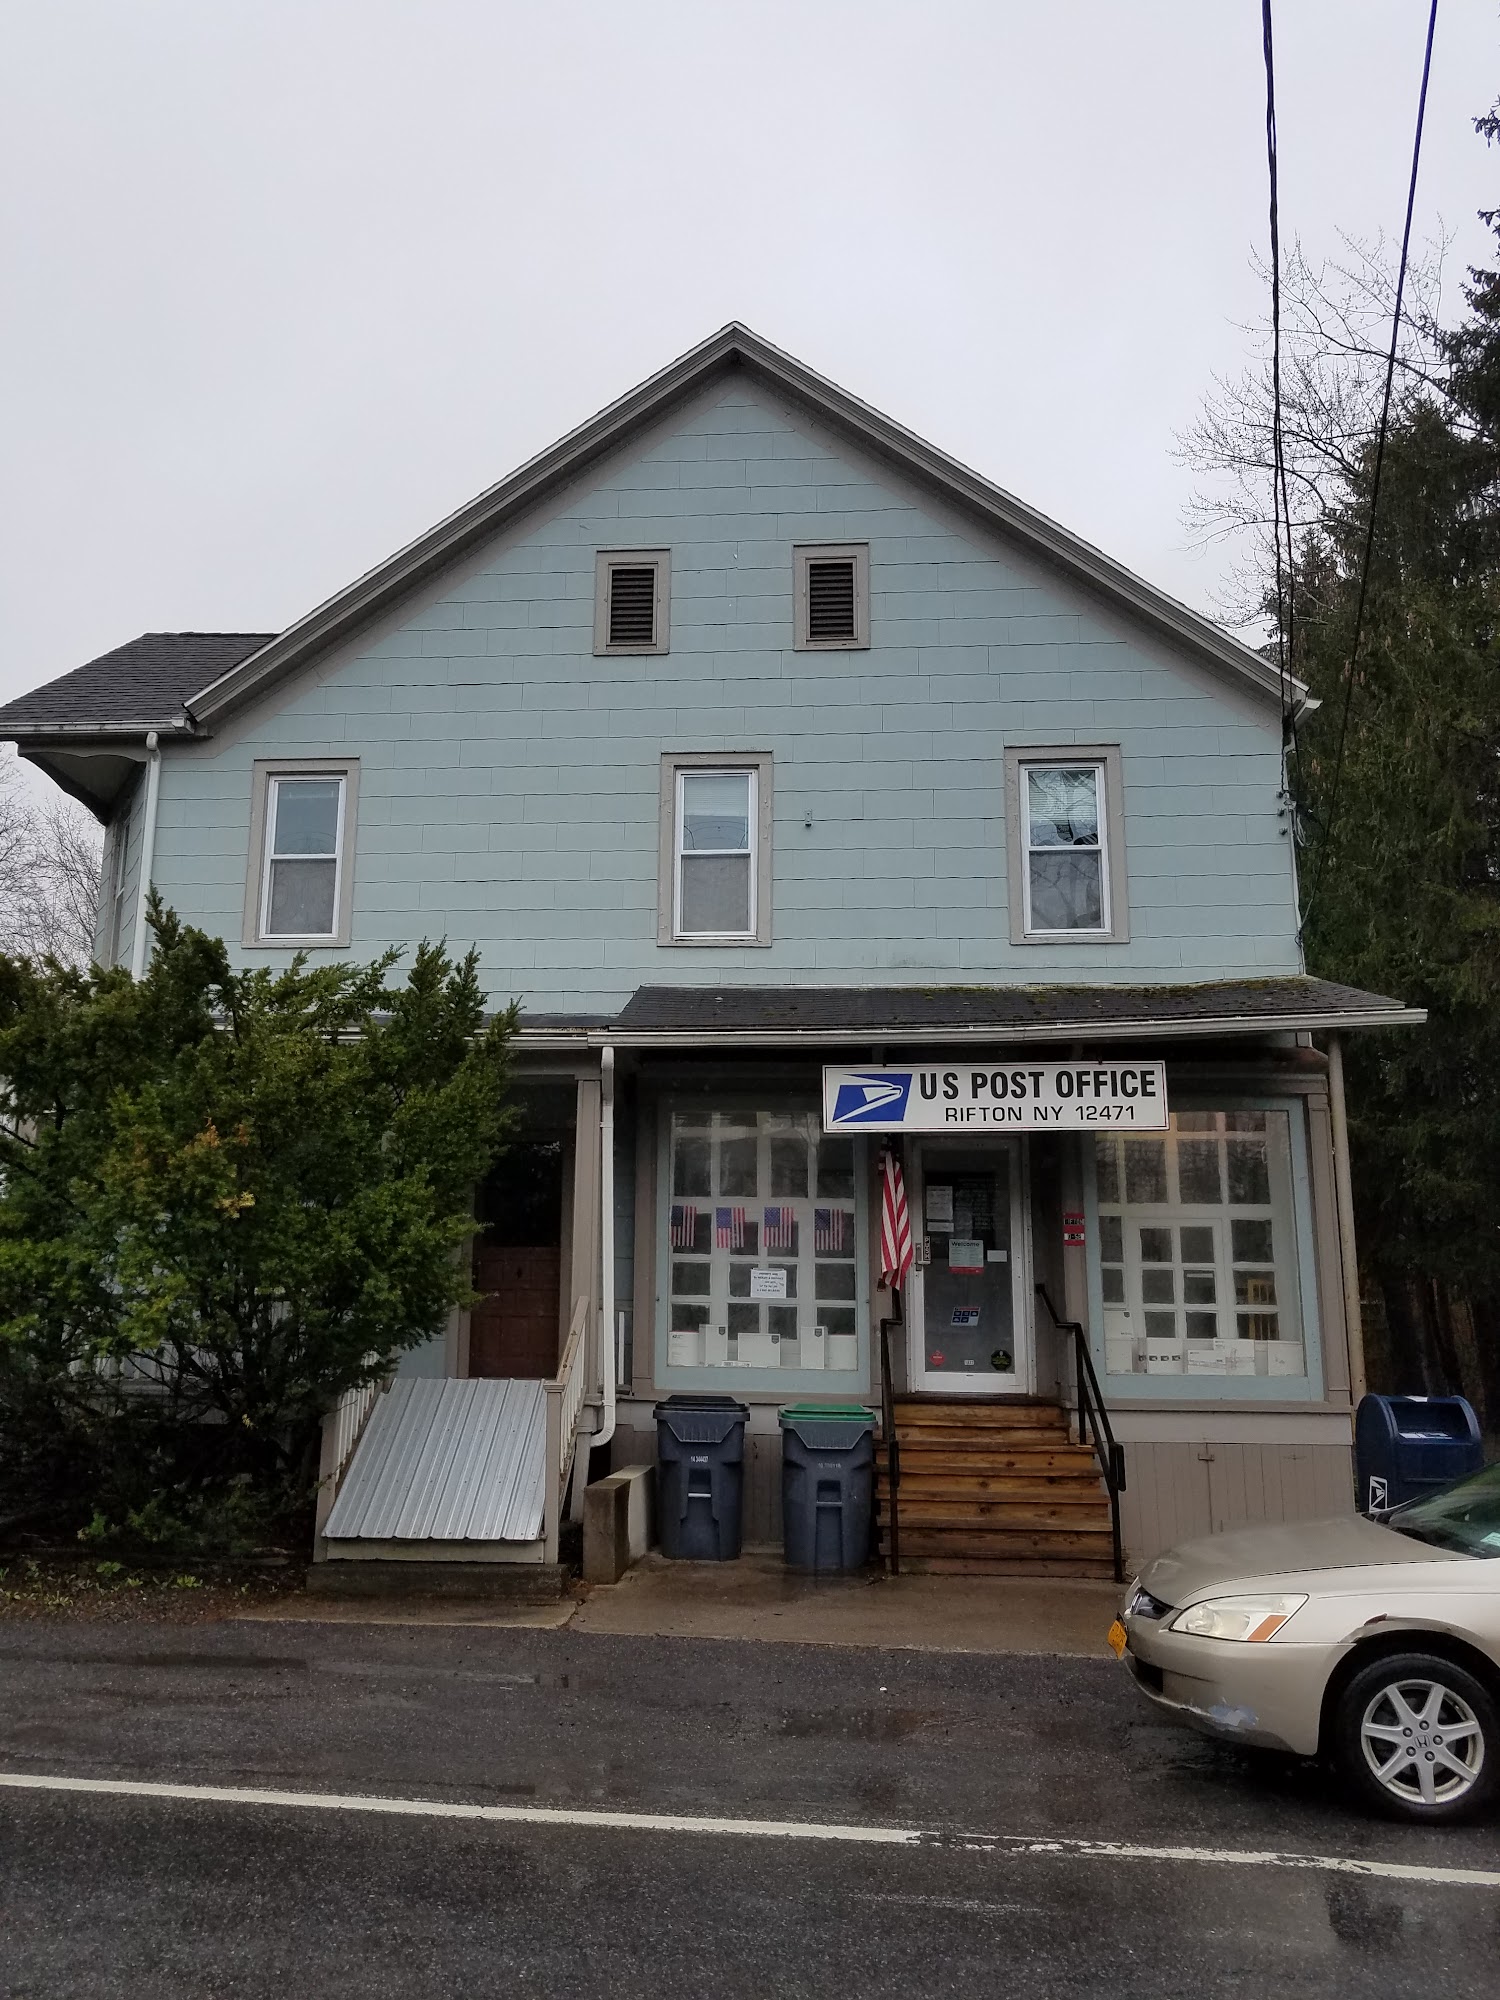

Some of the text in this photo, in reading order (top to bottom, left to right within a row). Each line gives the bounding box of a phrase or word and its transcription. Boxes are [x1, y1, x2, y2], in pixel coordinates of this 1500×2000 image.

[919, 1069, 1157, 1100] US POST OFFICE
[945, 1104, 1136, 1122] RIFTON NY 12471
[951, 1240, 980, 1248] Welcome
